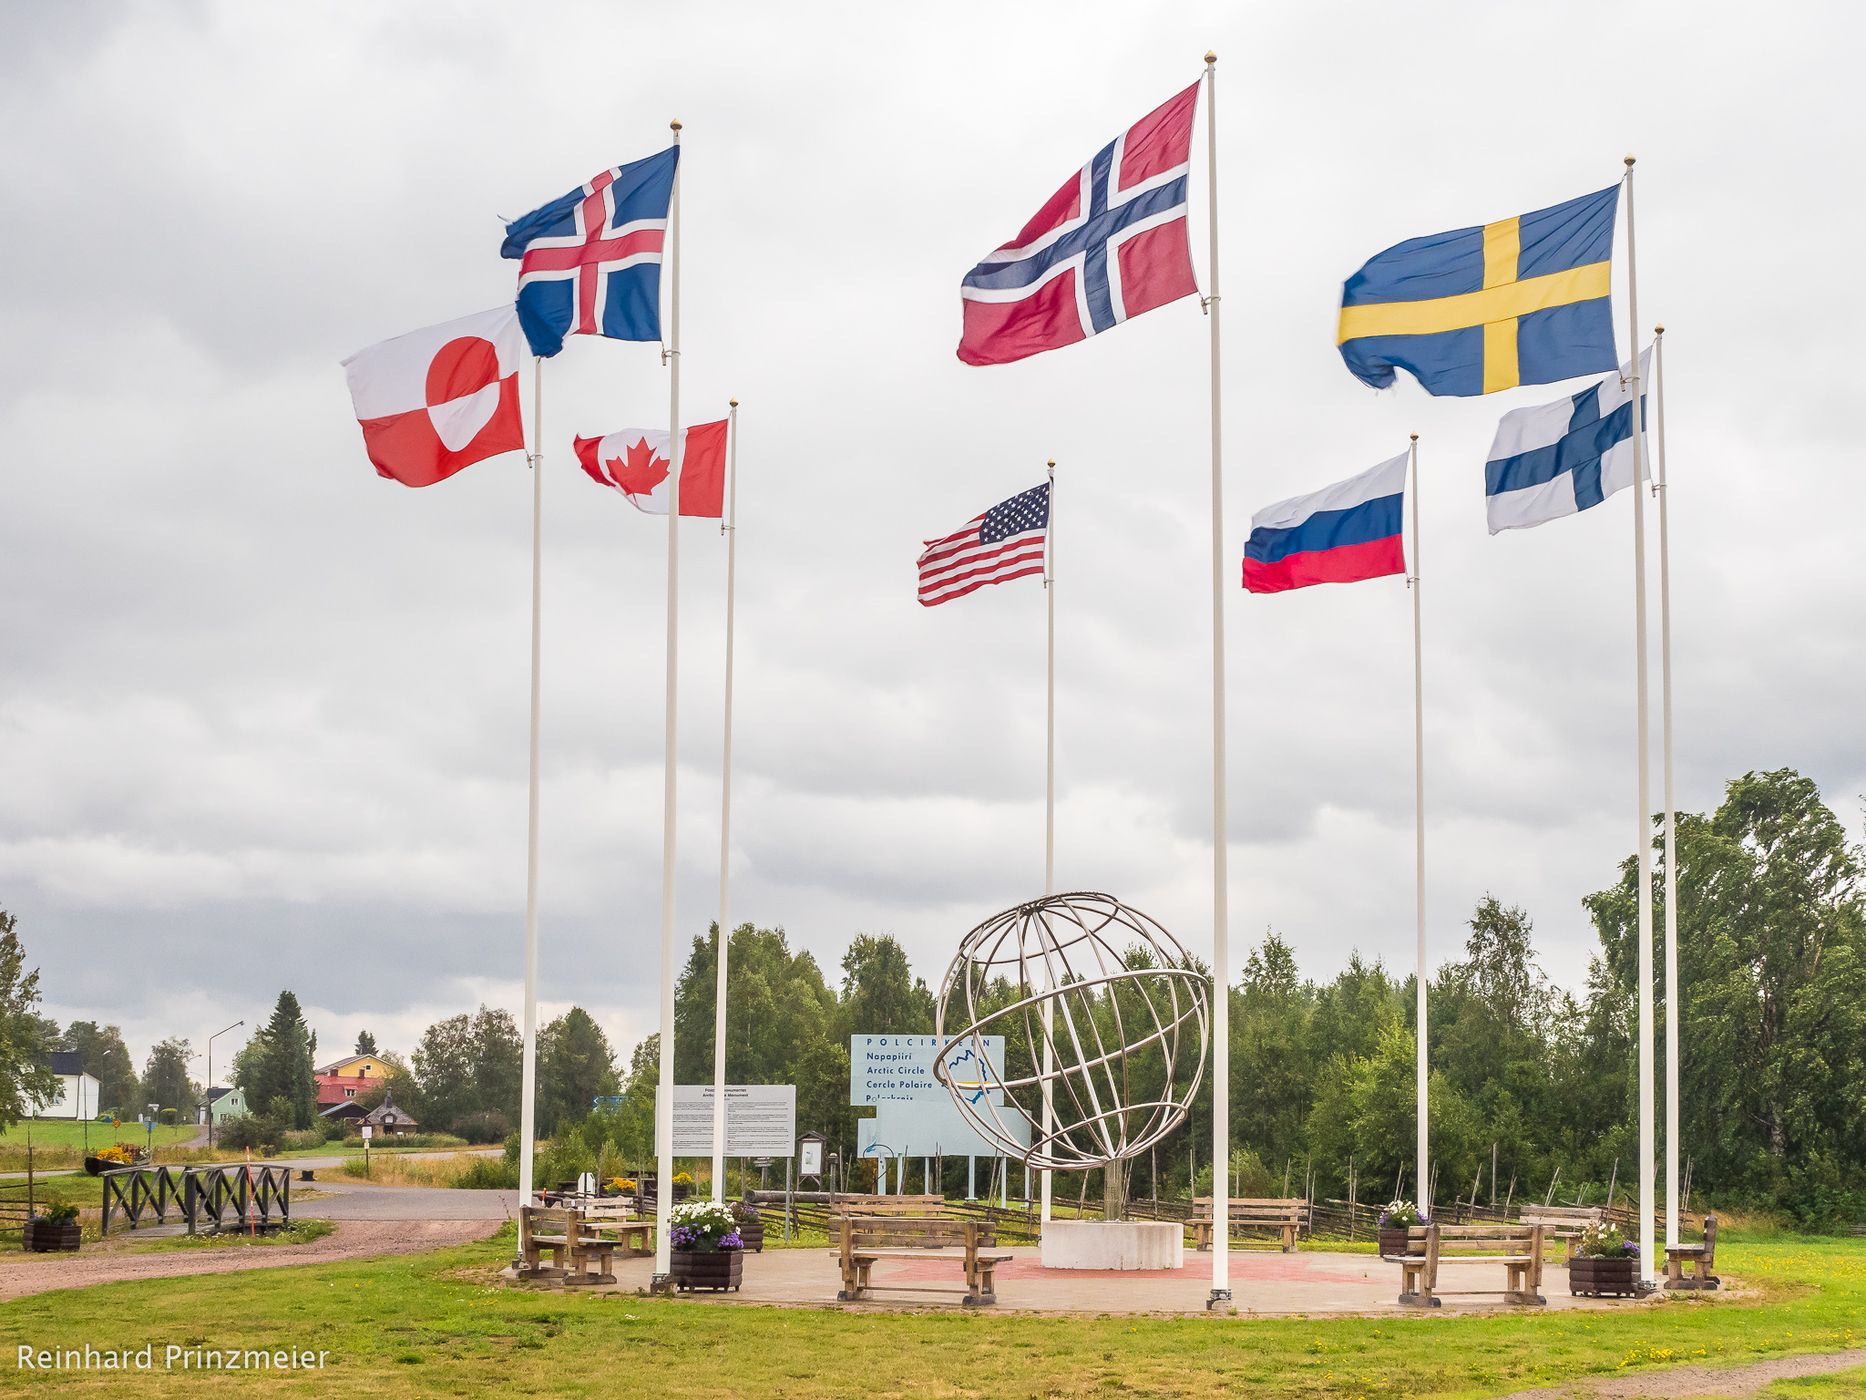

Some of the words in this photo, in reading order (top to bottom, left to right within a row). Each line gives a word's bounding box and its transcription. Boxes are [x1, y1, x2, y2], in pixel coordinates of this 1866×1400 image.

[866, 1052, 912, 1063] Napapiiri
[866, 1066, 894, 1075] Arctic
[897, 1066, 925, 1075] Circle
[866, 1079, 896, 1089] Cercle
[899, 1079, 933, 1089] Polaire
